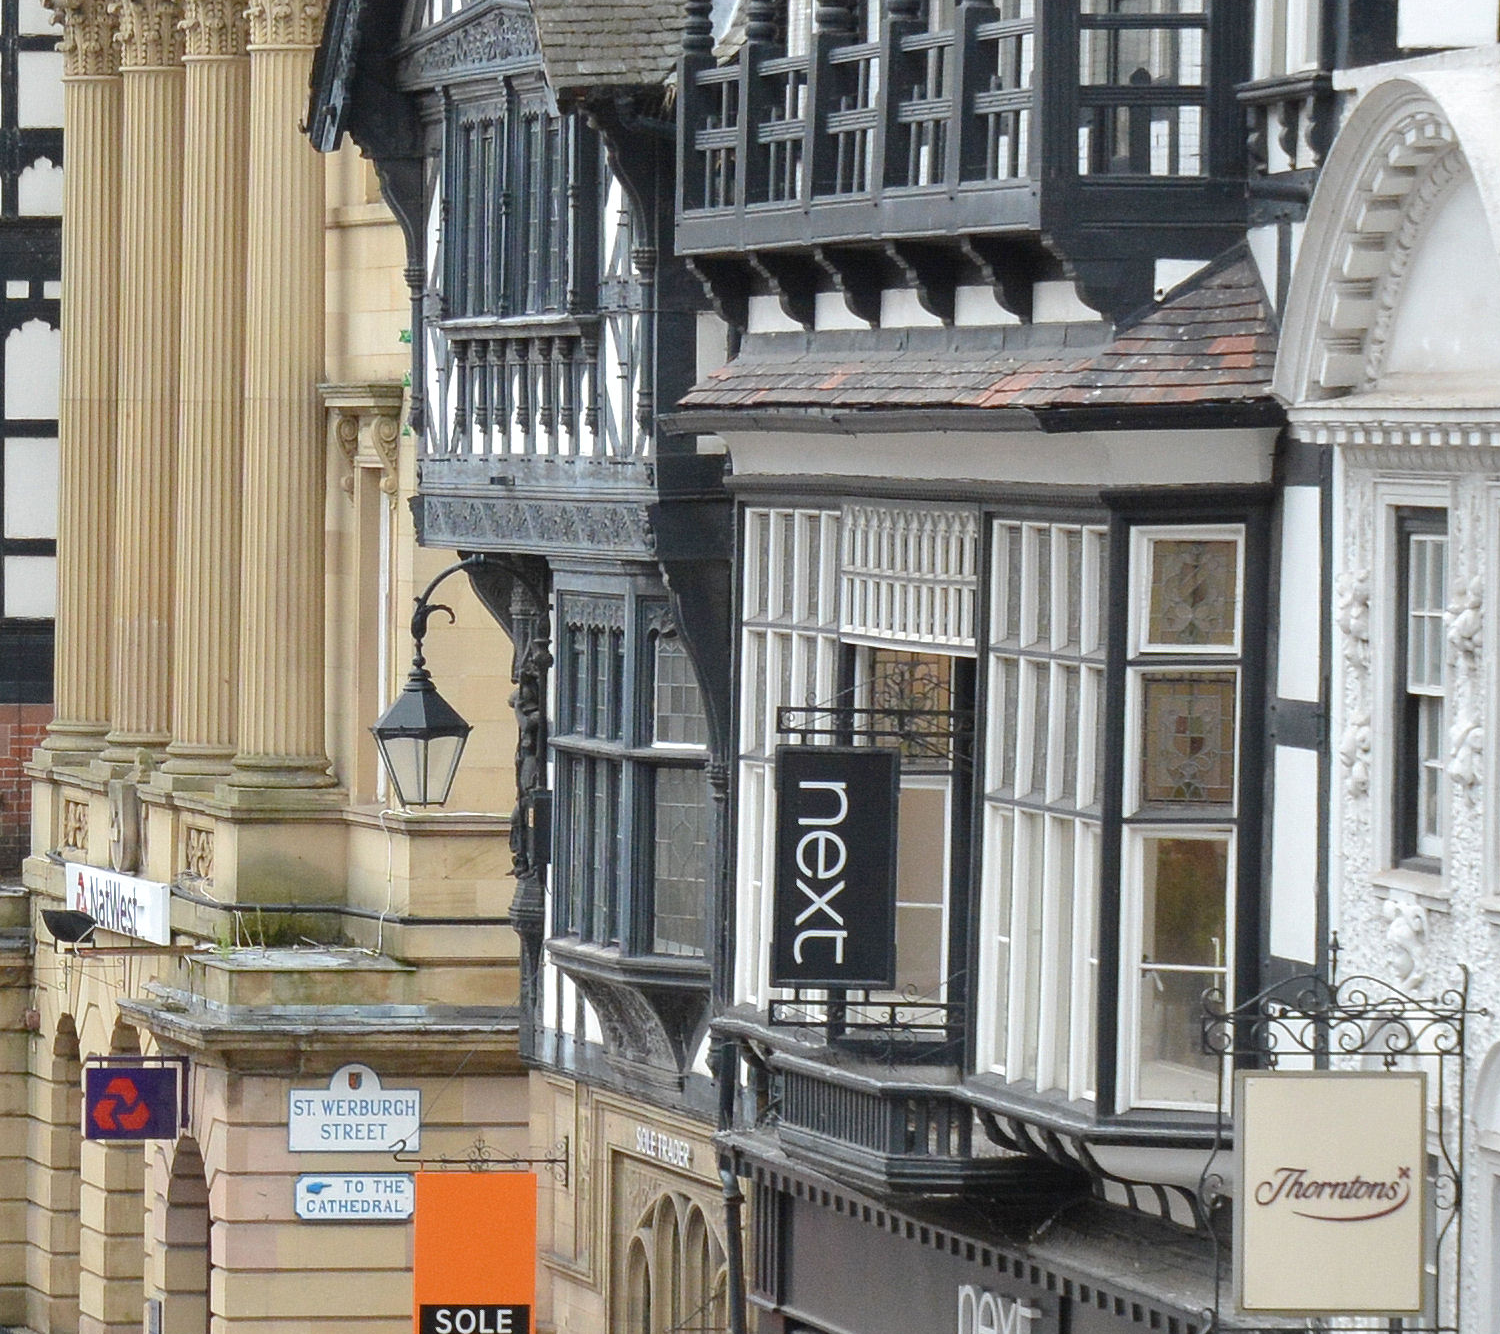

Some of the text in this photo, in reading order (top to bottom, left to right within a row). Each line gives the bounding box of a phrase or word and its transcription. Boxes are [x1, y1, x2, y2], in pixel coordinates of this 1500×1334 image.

[793, 779, 849, 965] next
[90, 875, 138, 936] NatWest
[294, 1099, 416, 1117] ST. WERBURGH
[320, 1123, 388, 1141] STREET
[344, 1180, 405, 1194] TO THE
[1254, 1166, 1401, 1208] Thorntons
[306, 1199, 404, 1213] CATHEDRAL
[435, 1309, 513, 1334] SOLE
